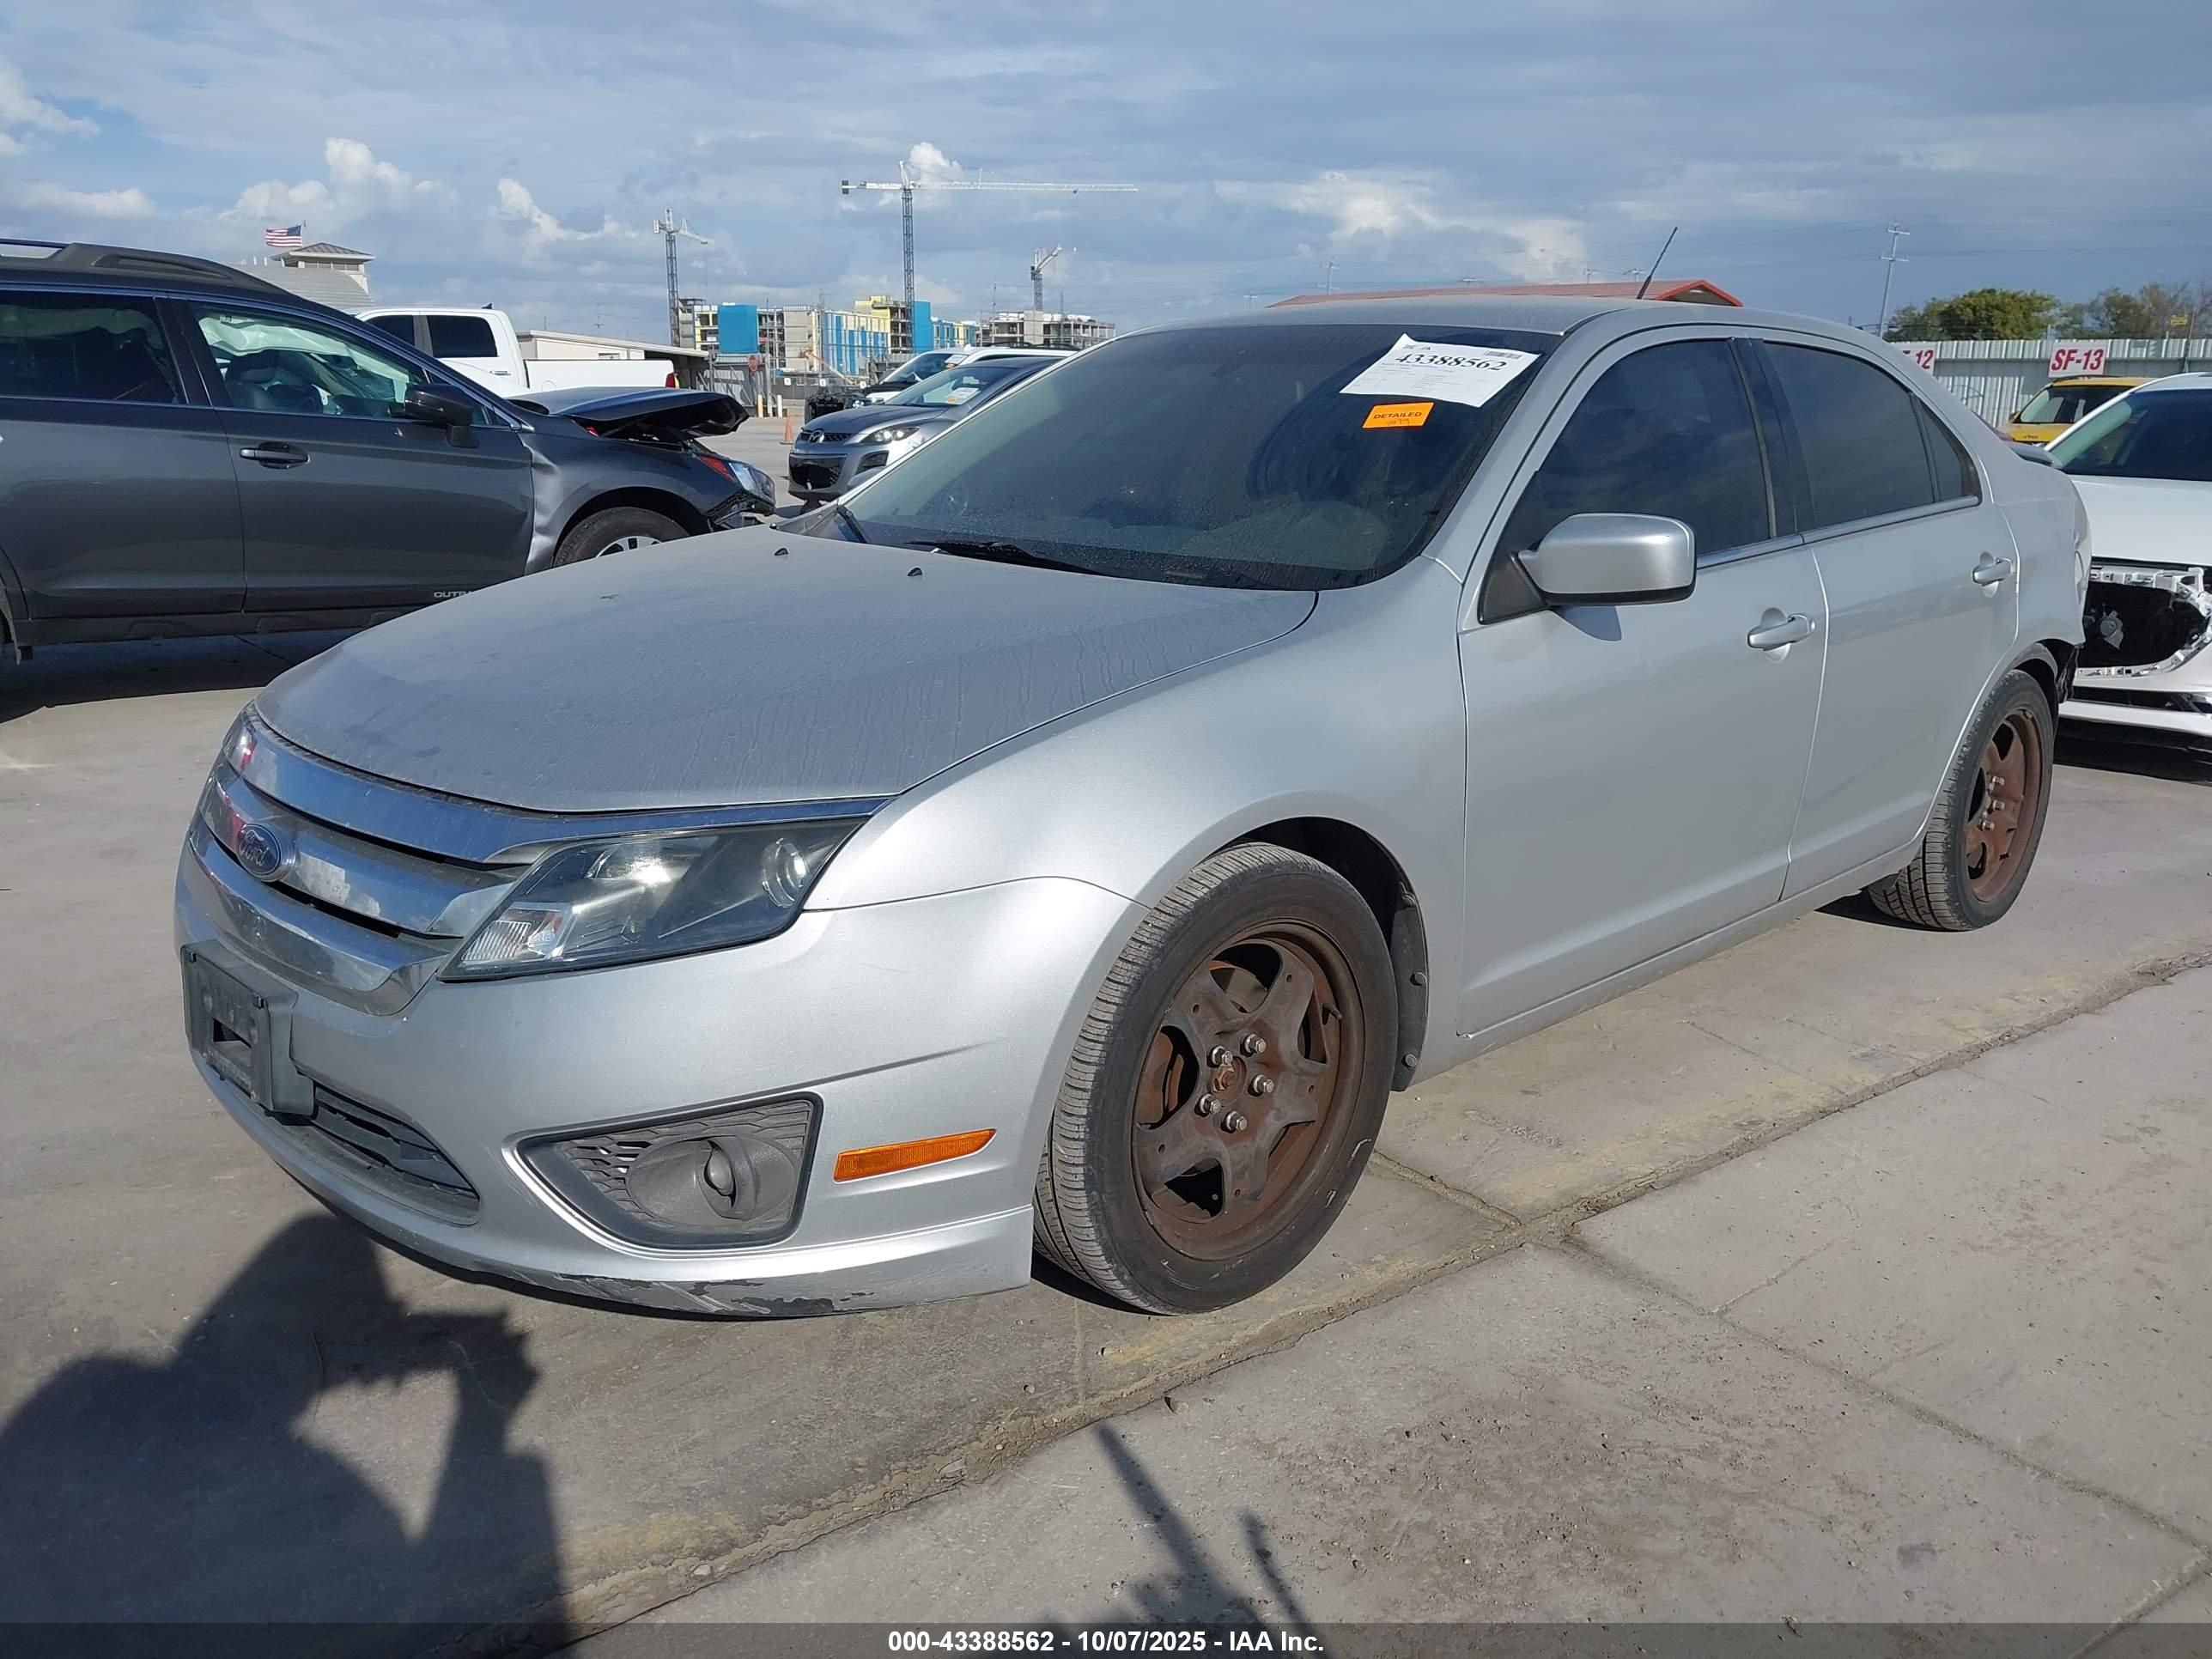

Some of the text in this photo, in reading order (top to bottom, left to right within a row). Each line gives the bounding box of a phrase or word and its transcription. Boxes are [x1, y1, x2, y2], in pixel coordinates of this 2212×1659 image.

[1395, 353, 1508, 371] 43388562
[2051, 349, 2104, 370] SF-13
[239, 829, 270, 867] Ford
